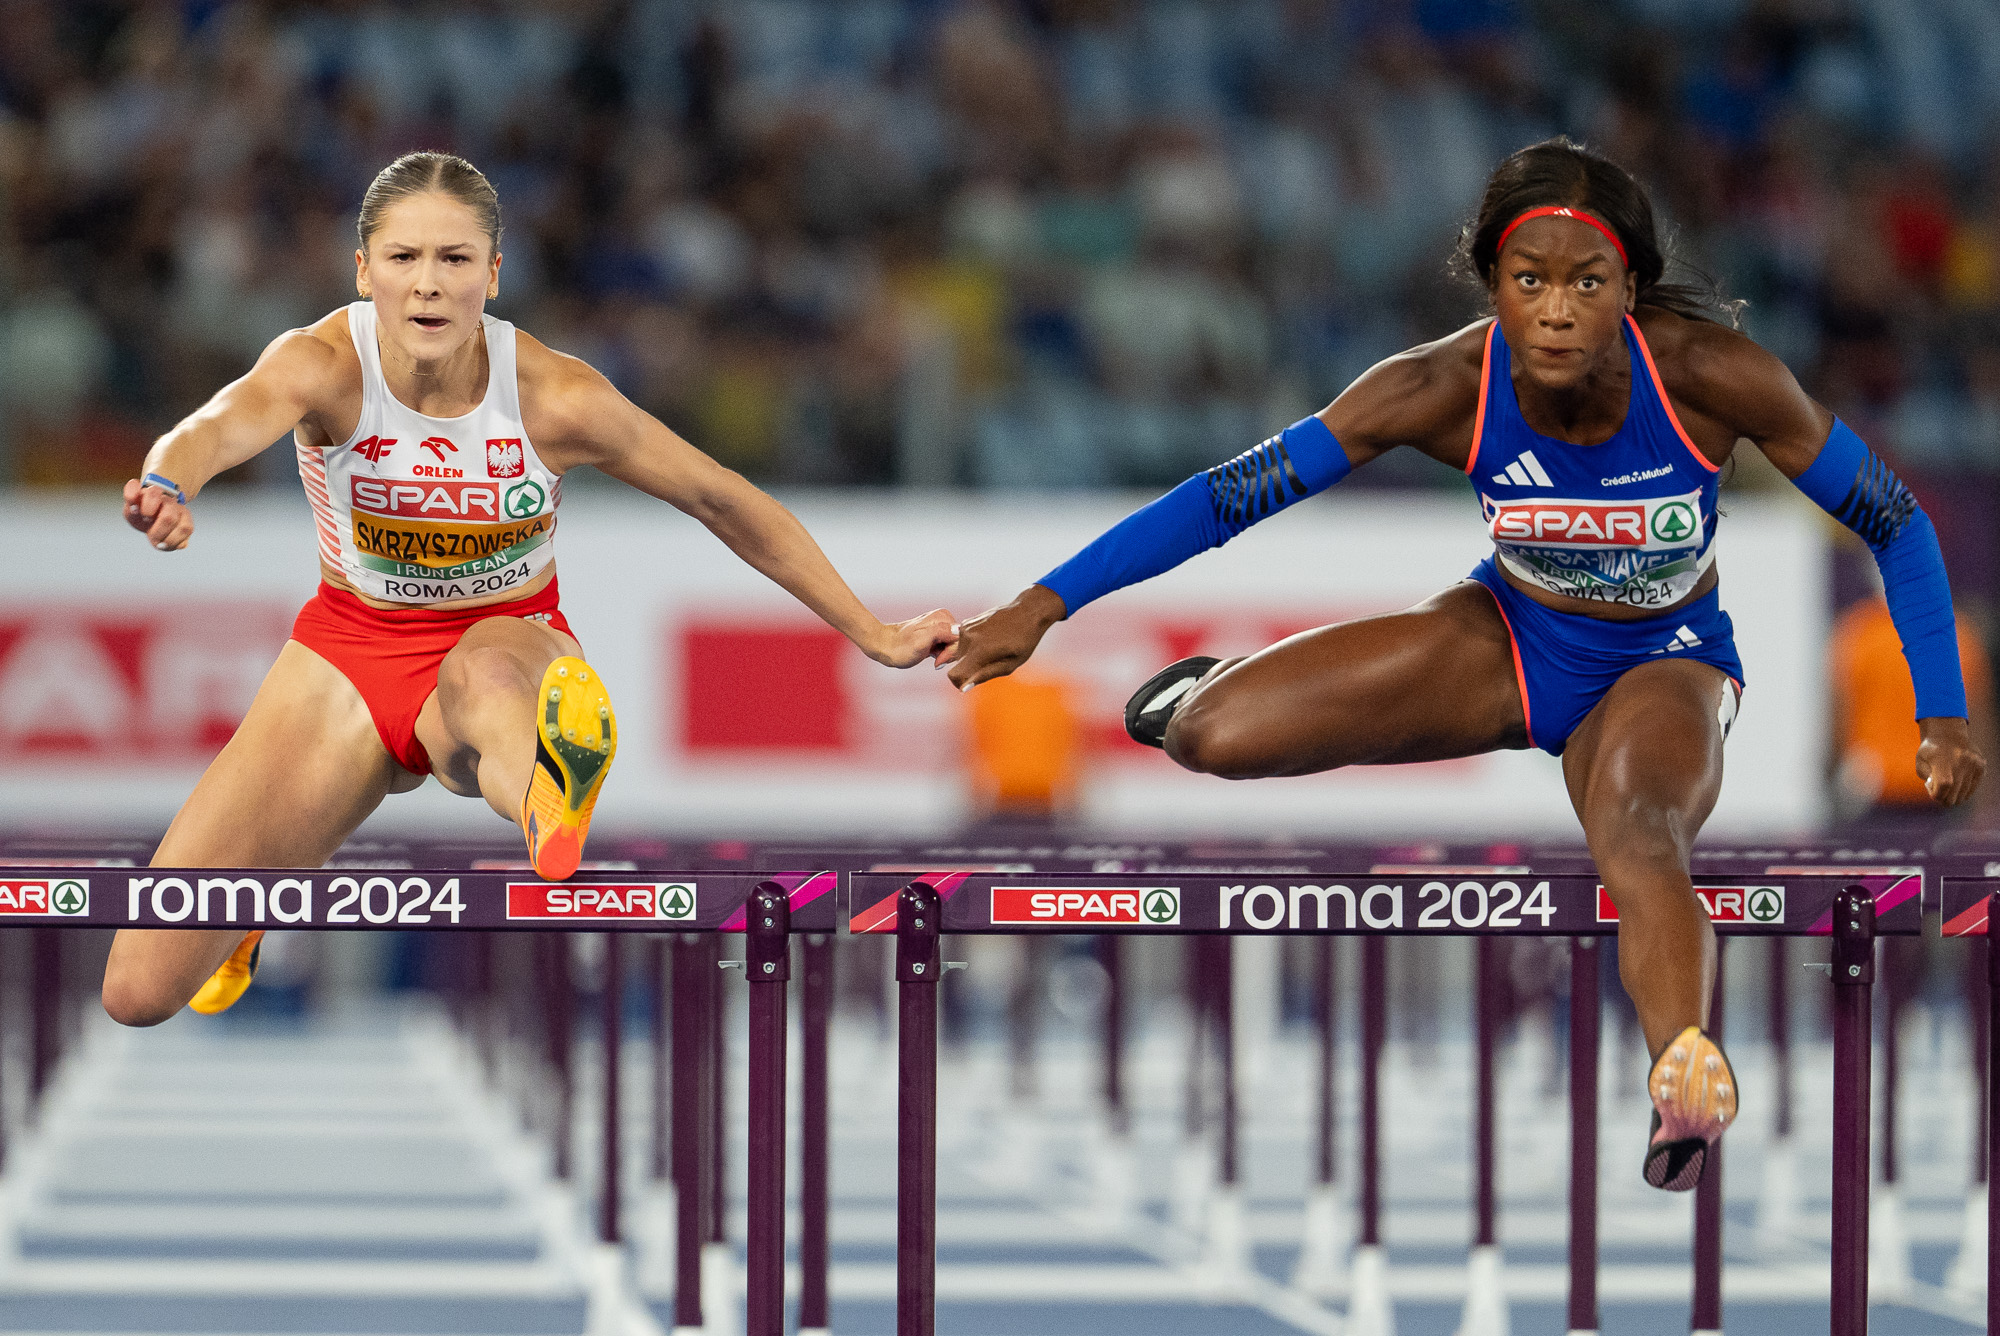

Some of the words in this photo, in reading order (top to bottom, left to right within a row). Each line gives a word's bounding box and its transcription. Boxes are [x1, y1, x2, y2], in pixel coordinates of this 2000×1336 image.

[412, 464, 463, 478] ORLEN
[1601, 475, 1631, 487] Crédit
[1641, 463, 1674, 480] Mutuel
[355, 482, 495, 516] SPAR
[1499, 511, 1642, 540] SPAR
[357, 521, 544, 560] SKRZYSZOWSKA
[385, 580, 465, 598] ROMA
[472, 562, 531, 594] 2024
[397, 564, 401, 576] I
[405, 564, 445, 579] RUN
[1550, 568, 1588, 587] RUN
[1613, 582, 1673, 605] 2024
[128, 877, 312, 922] roma
[326, 877, 467, 924] 2024
[546, 889, 653, 914] SPAR
[1030, 892, 1137, 918] SPAR
[1219, 882, 1403, 929] roma
[1417, 881, 1557, 928] 2024
